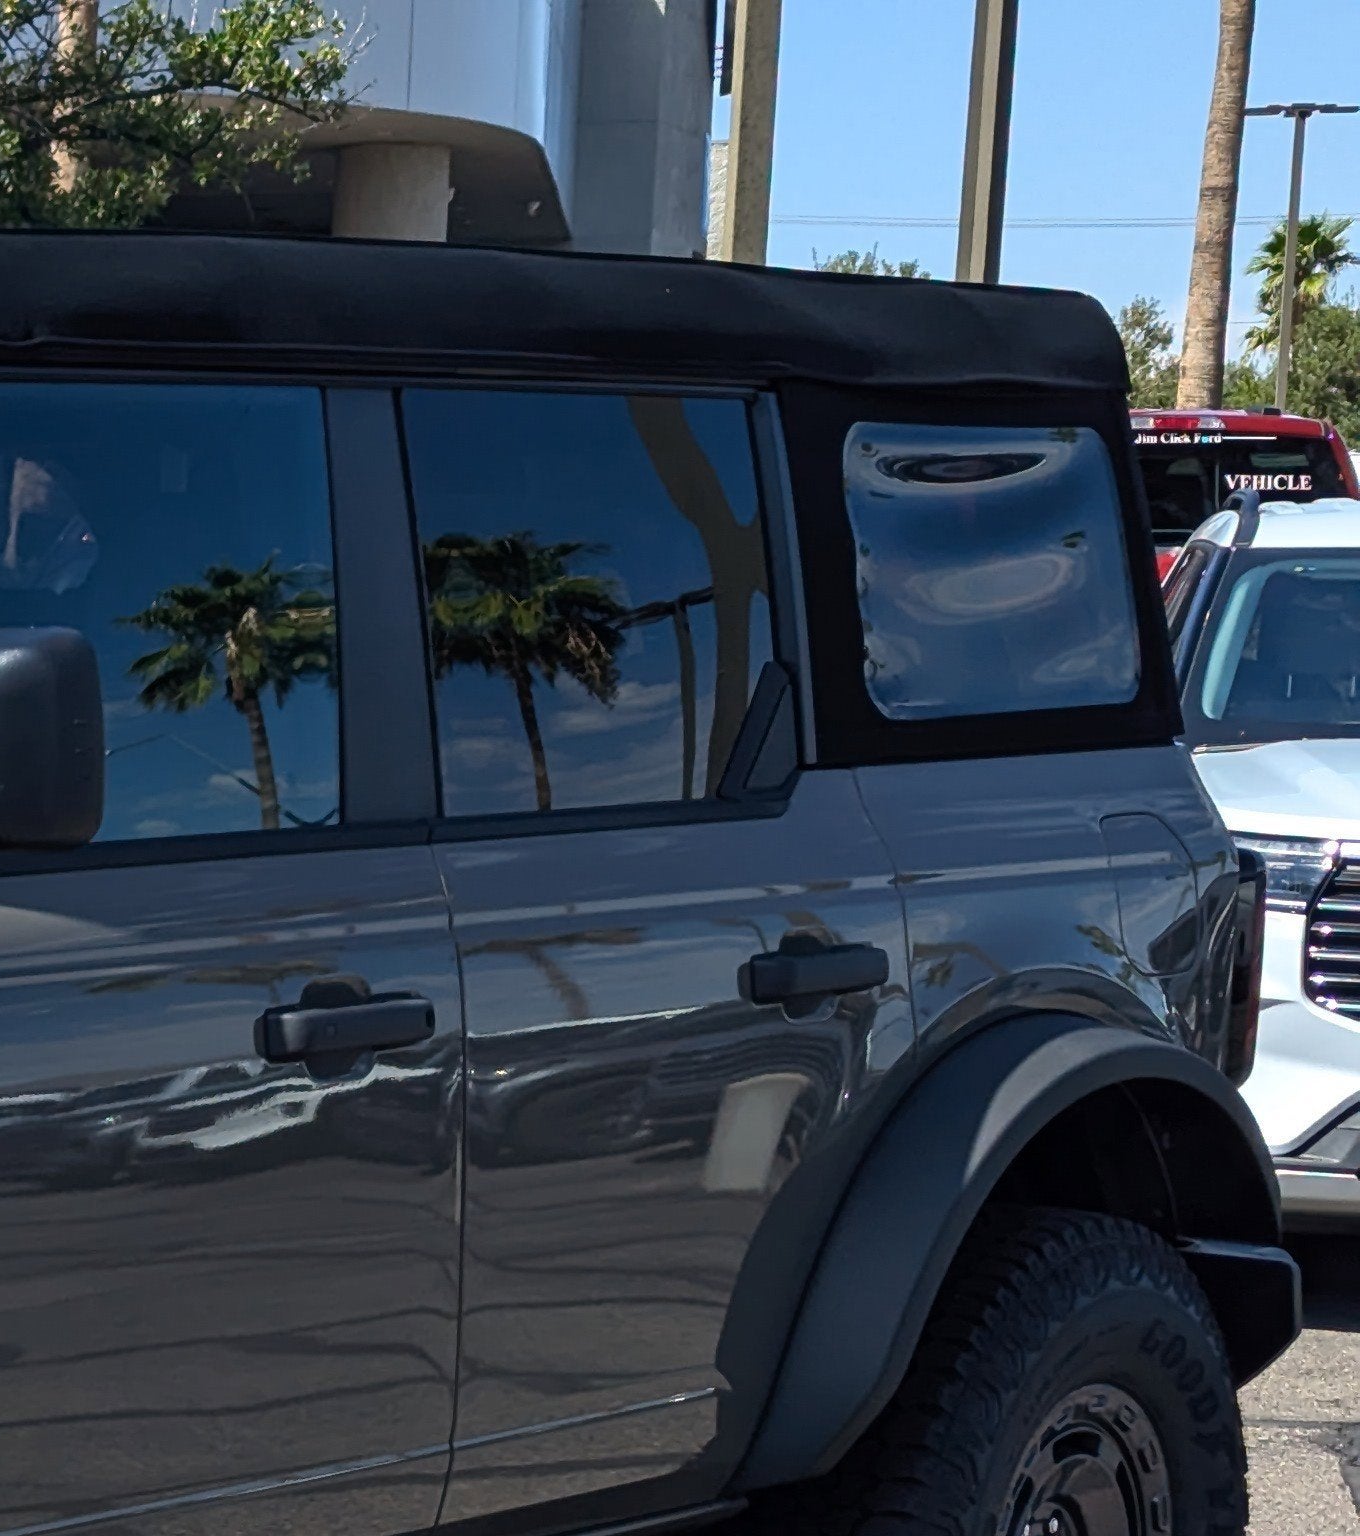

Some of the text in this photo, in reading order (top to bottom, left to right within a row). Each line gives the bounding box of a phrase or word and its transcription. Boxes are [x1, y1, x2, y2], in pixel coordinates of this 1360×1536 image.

[1134, 432, 1222, 445] Jim Click Ford
[1224, 474, 1313, 491] VEHICLE
